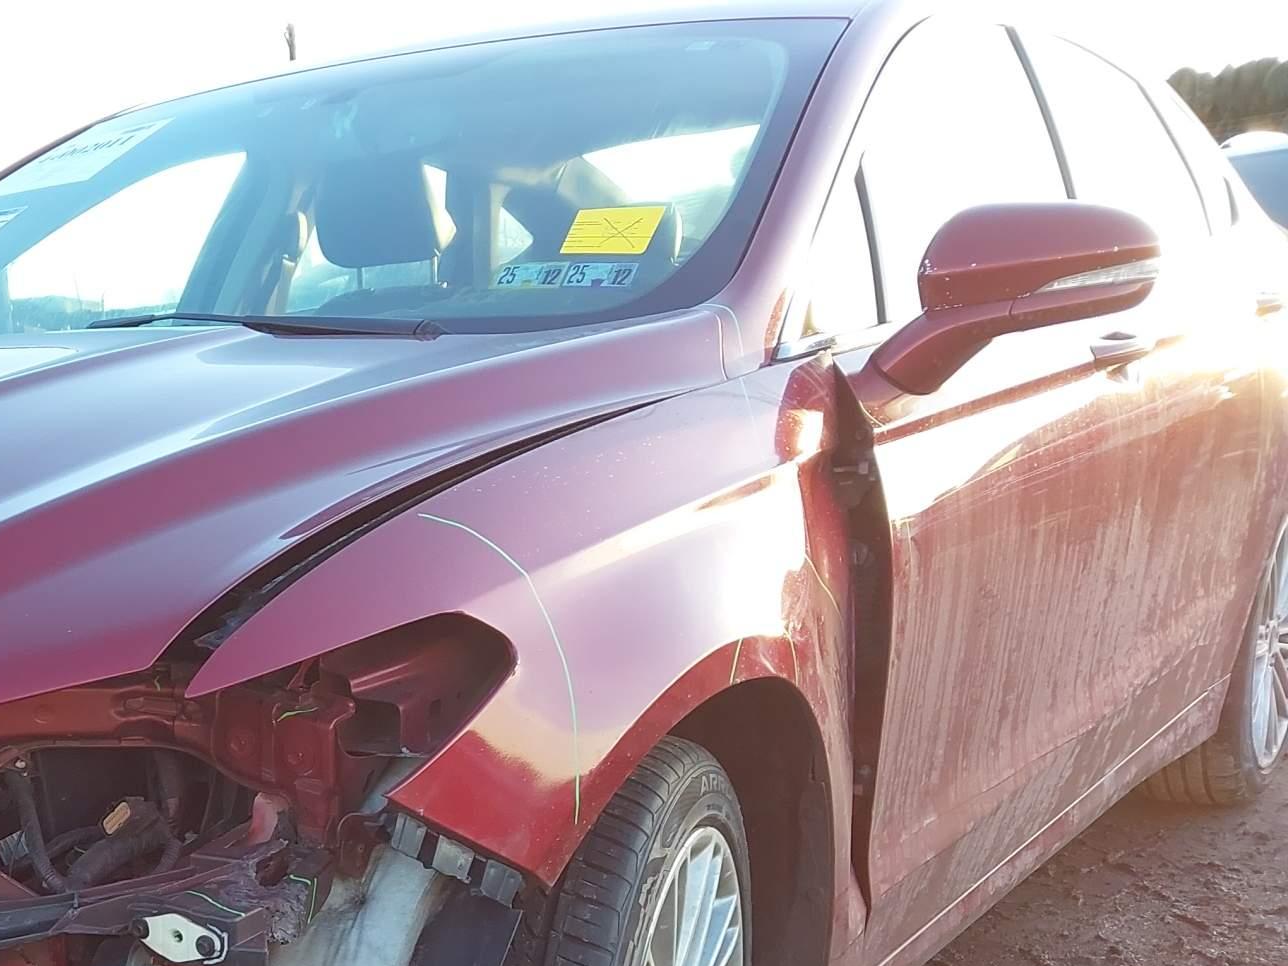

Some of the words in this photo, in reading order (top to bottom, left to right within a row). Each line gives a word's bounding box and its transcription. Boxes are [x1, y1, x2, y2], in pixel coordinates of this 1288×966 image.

[497, 265, 520, 285] 25
[541, 268, 562, 285] 12
[566, 264, 590, 284] 25
[611, 268, 633, 286] 12
